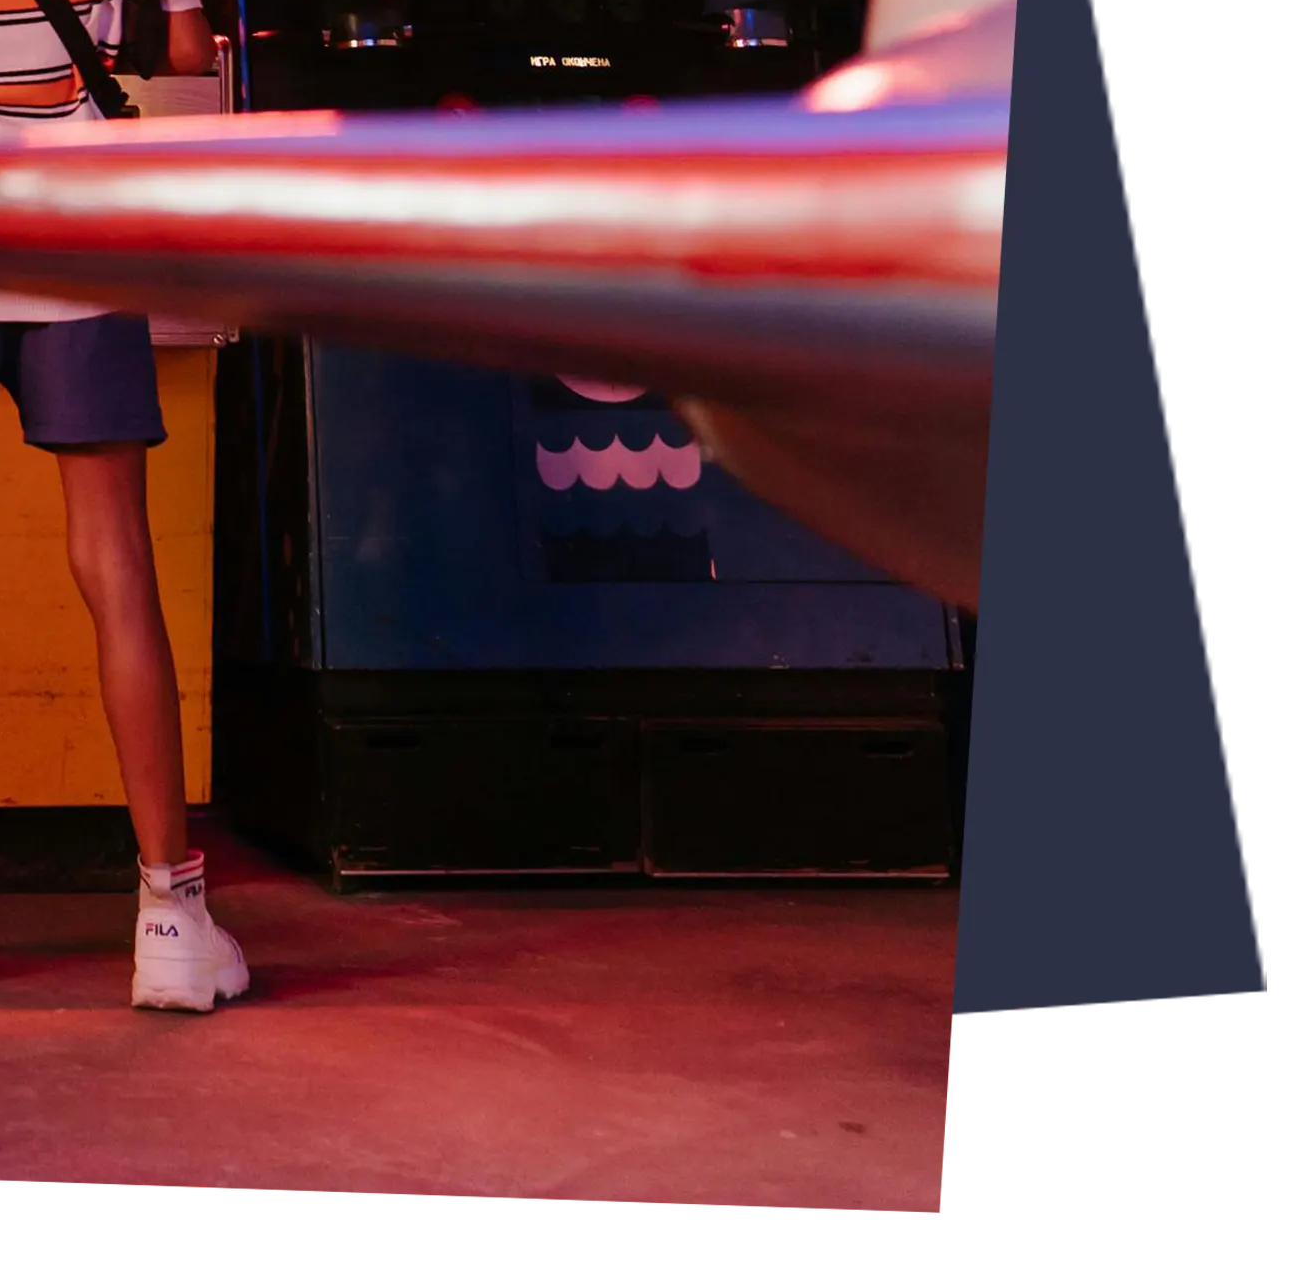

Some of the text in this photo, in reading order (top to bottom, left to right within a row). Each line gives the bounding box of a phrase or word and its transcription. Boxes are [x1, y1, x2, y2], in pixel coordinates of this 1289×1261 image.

[530, 56, 611, 68] ИГРА ОКОНЧЕНА
[145, 921, 180, 938] FILA
